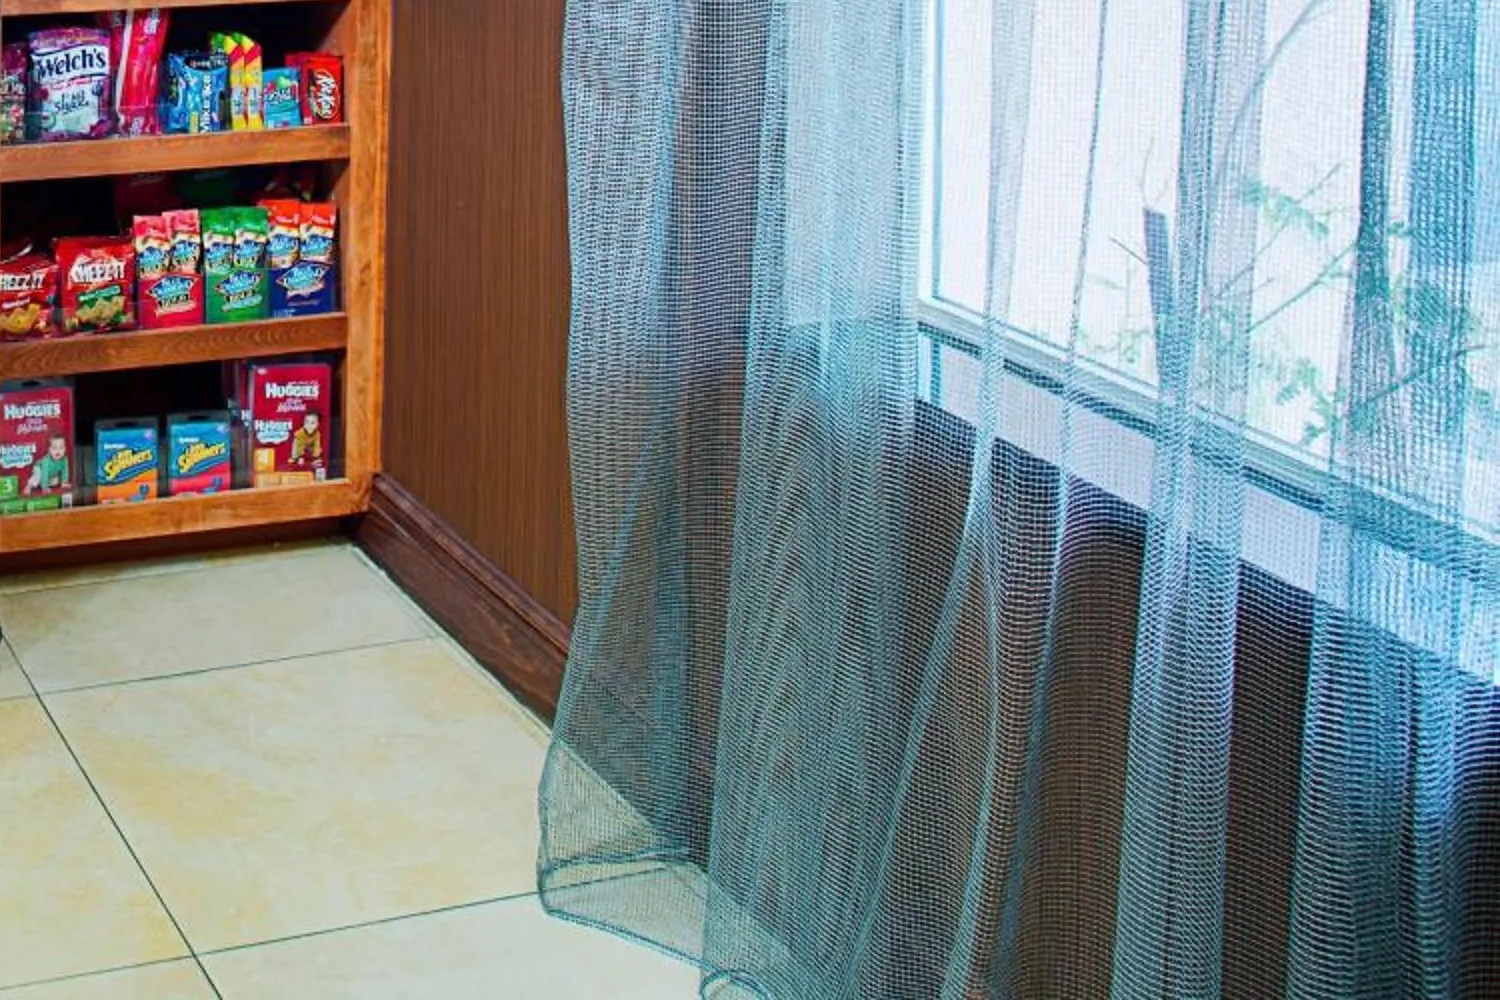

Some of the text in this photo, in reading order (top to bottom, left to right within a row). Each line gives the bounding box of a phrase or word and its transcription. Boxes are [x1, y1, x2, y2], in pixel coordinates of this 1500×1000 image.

[35, 47, 107, 78] Welch's
[265, 381, 320, 399] HUGGIES
[3, 403, 62, 420] HUGGIES
